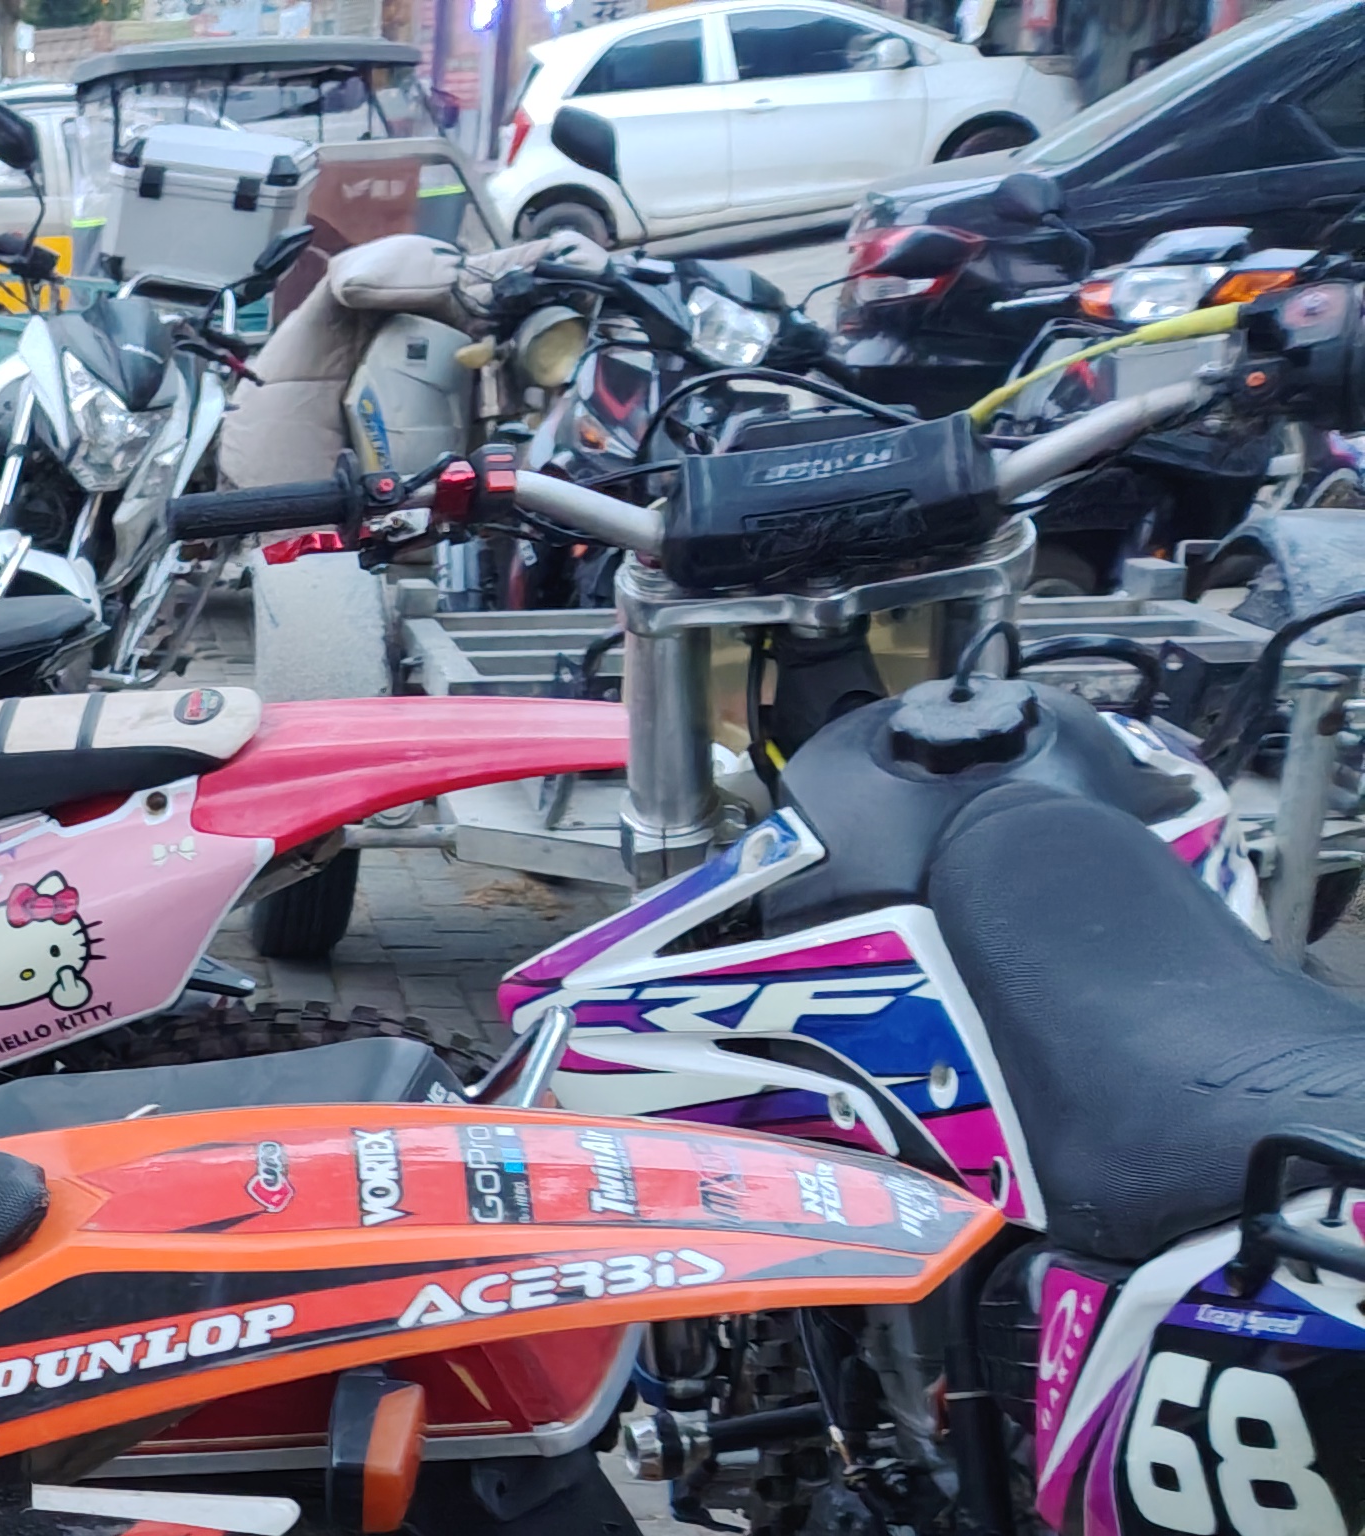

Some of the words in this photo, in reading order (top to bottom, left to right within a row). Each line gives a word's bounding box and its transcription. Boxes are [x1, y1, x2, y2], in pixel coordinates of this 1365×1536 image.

[59, 1002, 114, 1034] KITTY
[354, 1129, 405, 1225] VORTEX
[466, 1126, 504, 1223] GoPro
